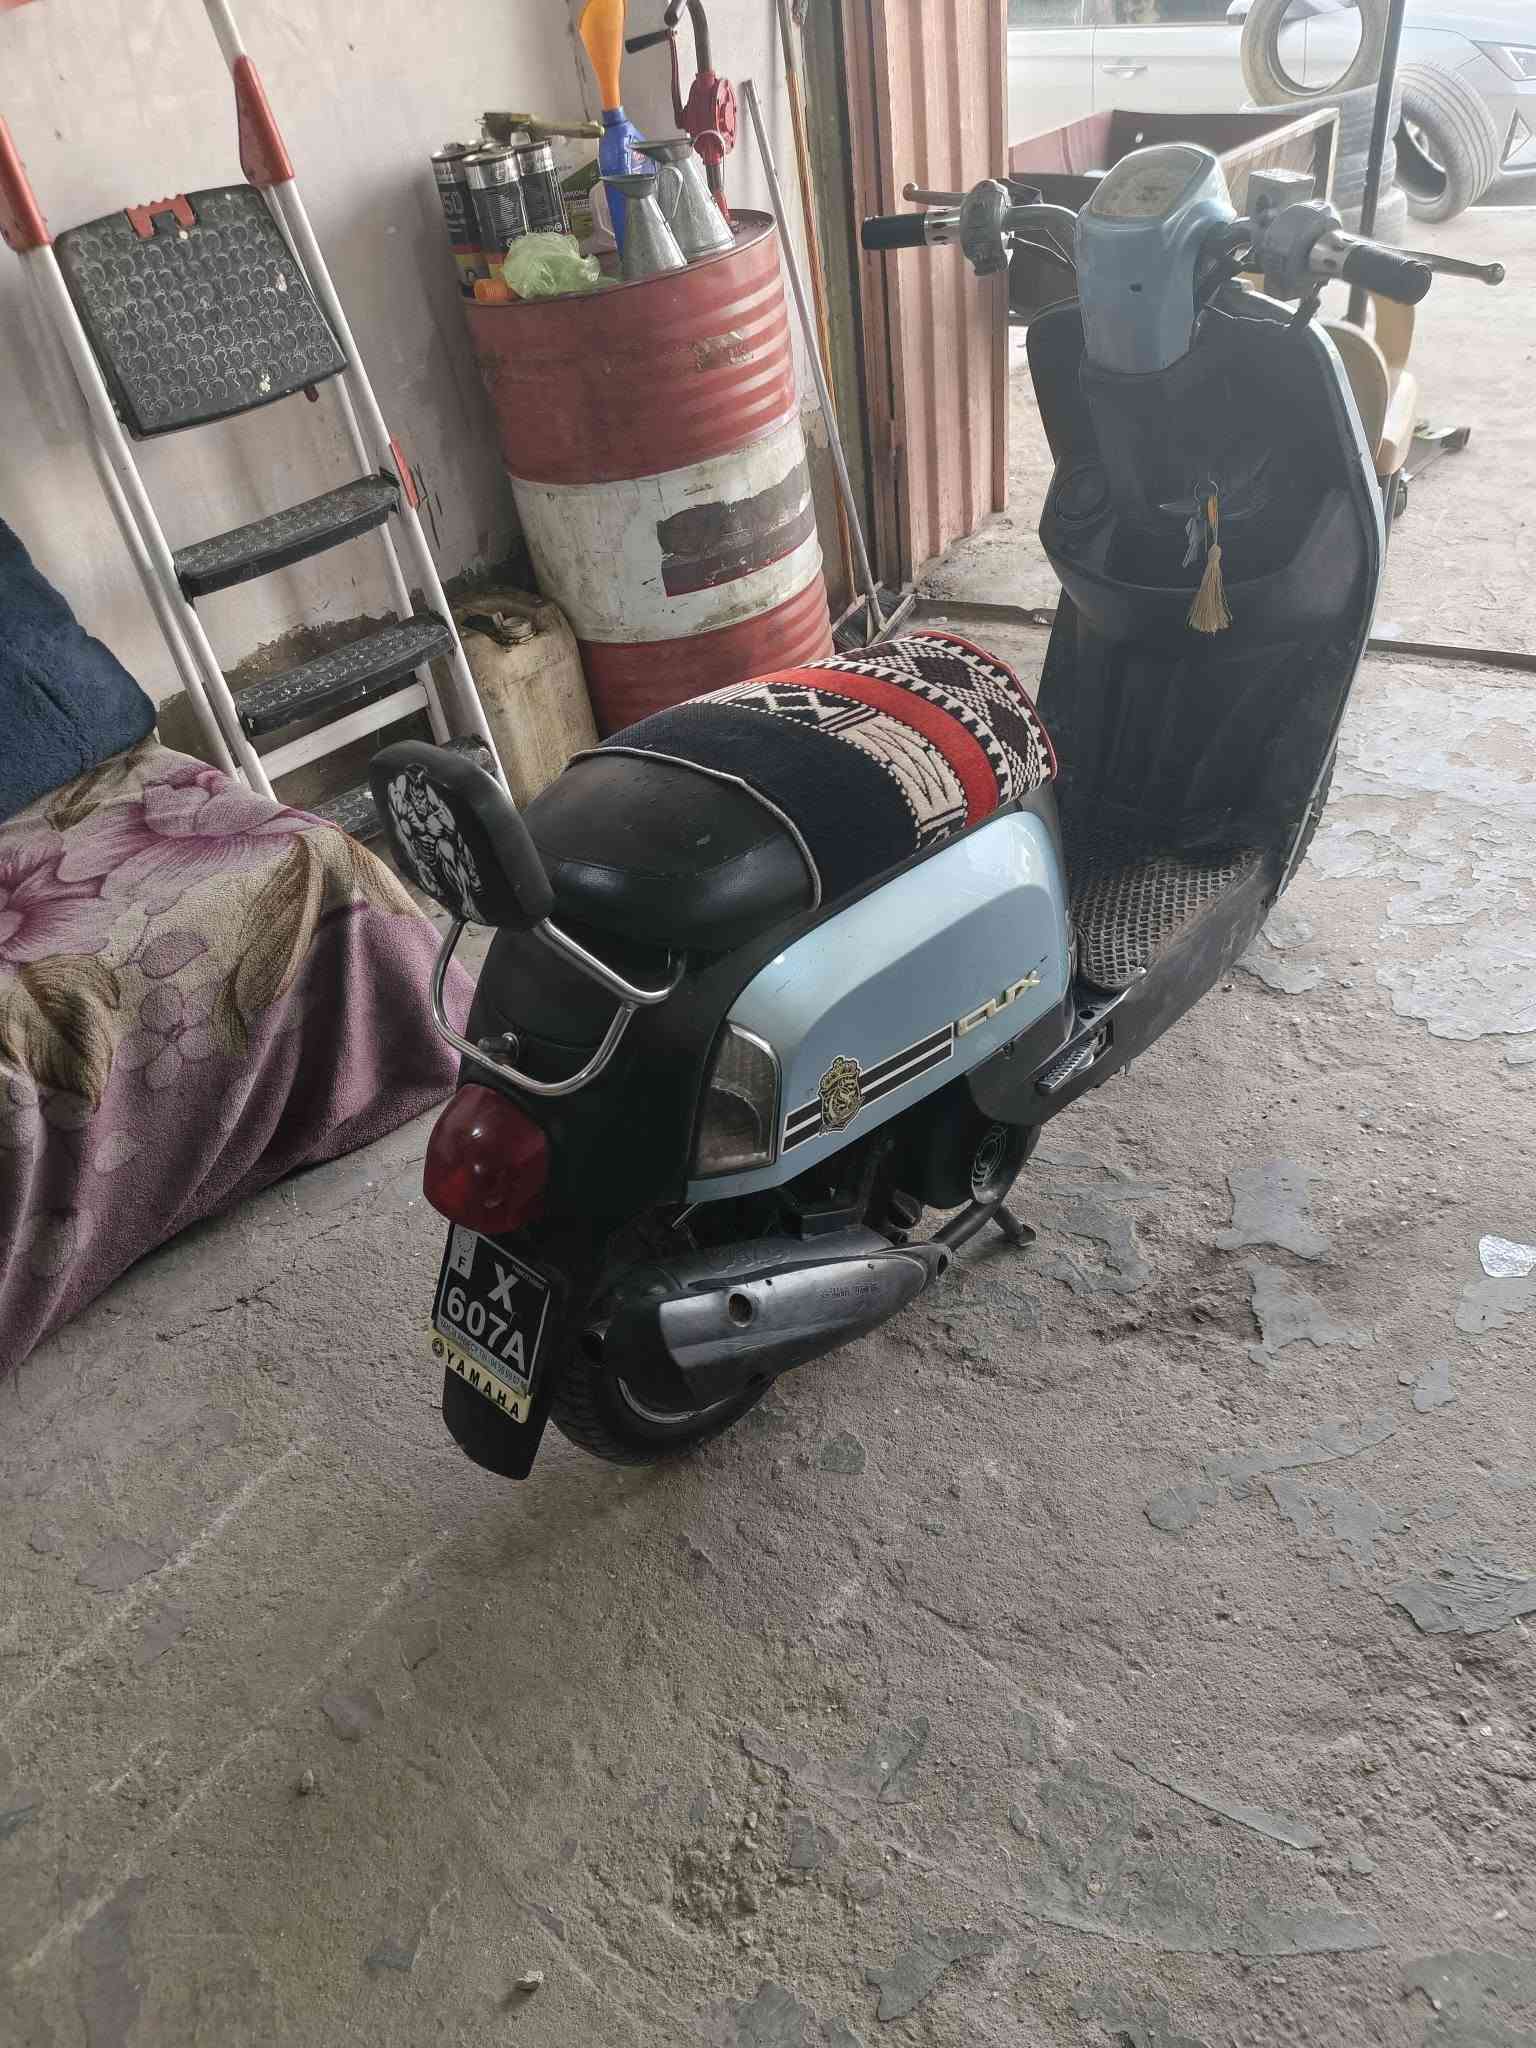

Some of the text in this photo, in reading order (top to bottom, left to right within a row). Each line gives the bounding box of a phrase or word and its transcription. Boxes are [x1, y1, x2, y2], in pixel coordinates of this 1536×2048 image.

[457, 1255, 466, 1269] F
[487, 1260, 520, 1313] X
[446, 1286, 526, 1373] 607A
[447, 1348, 519, 1420] YAMAHA
